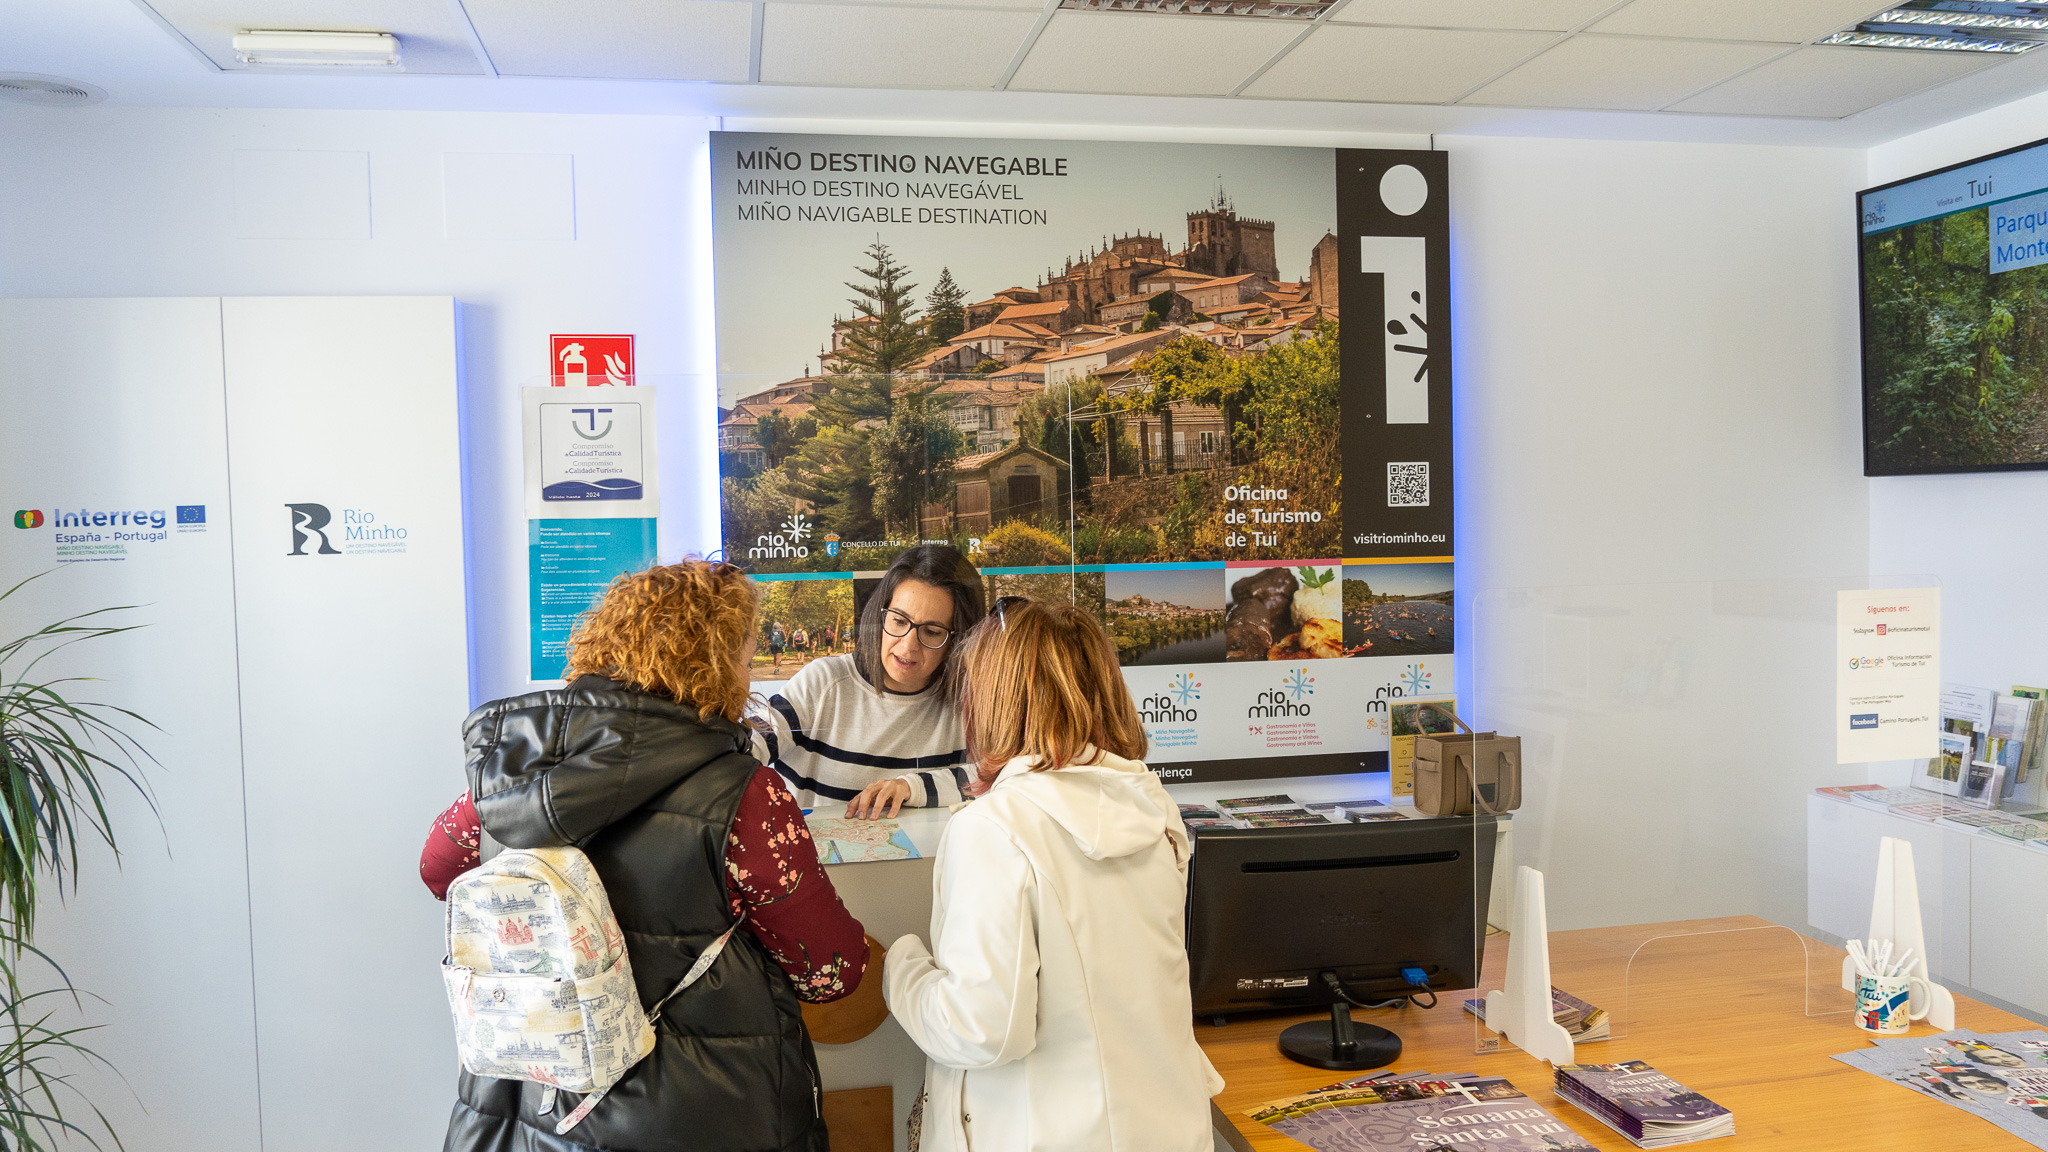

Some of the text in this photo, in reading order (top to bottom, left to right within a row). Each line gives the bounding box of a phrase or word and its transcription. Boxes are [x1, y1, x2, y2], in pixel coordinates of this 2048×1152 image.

[737, 147, 1068, 177] MIÑO DESTINO NAVEGABLE
[737, 180, 1024, 201] MINHO DESTINO NAVEGÁVEL
[1968, 175, 1992, 199] Tui
[738, 202, 1048, 226] MIÑO NAVIGABLE DESTINATION
[572, 460, 614, 468] Compromiso
[1224, 485, 1288, 502] Oficina
[54, 508, 166, 529] Interreg
[343, 509, 374, 524] Rio
[1225, 508, 1322, 524] de Turismo
[56, 532, 101, 544] España
[114, 531, 167, 543] Portugal
[345, 525, 408, 540] Minho
[758, 532, 784, 547] rio
[1225, 531, 1277, 547] de Tui
[1354, 532, 1446, 545] visitriominho.eu
[921, 538, 948, 546] Interreg
[749, 543, 808, 559] minho
[1867, 605, 1897, 615] Síguenos
[1860, 656, 1884, 666] Google
[1258, 688, 1285, 704] rio
[1376, 683, 1403, 699] rio
[1143, 693, 1171, 709] rio
[1248, 701, 1310, 718] minho
[1852, 718, 1877, 726] facebook
[1860, 987, 1882, 1001] Tui
[1606, 1074, 1670, 1086] Semana
[1607, 1079, 1681, 1093] Santa Tui
[1416, 1108, 1547, 1129] Semana
[1410, 1119, 1568, 1147] Santa Tui
